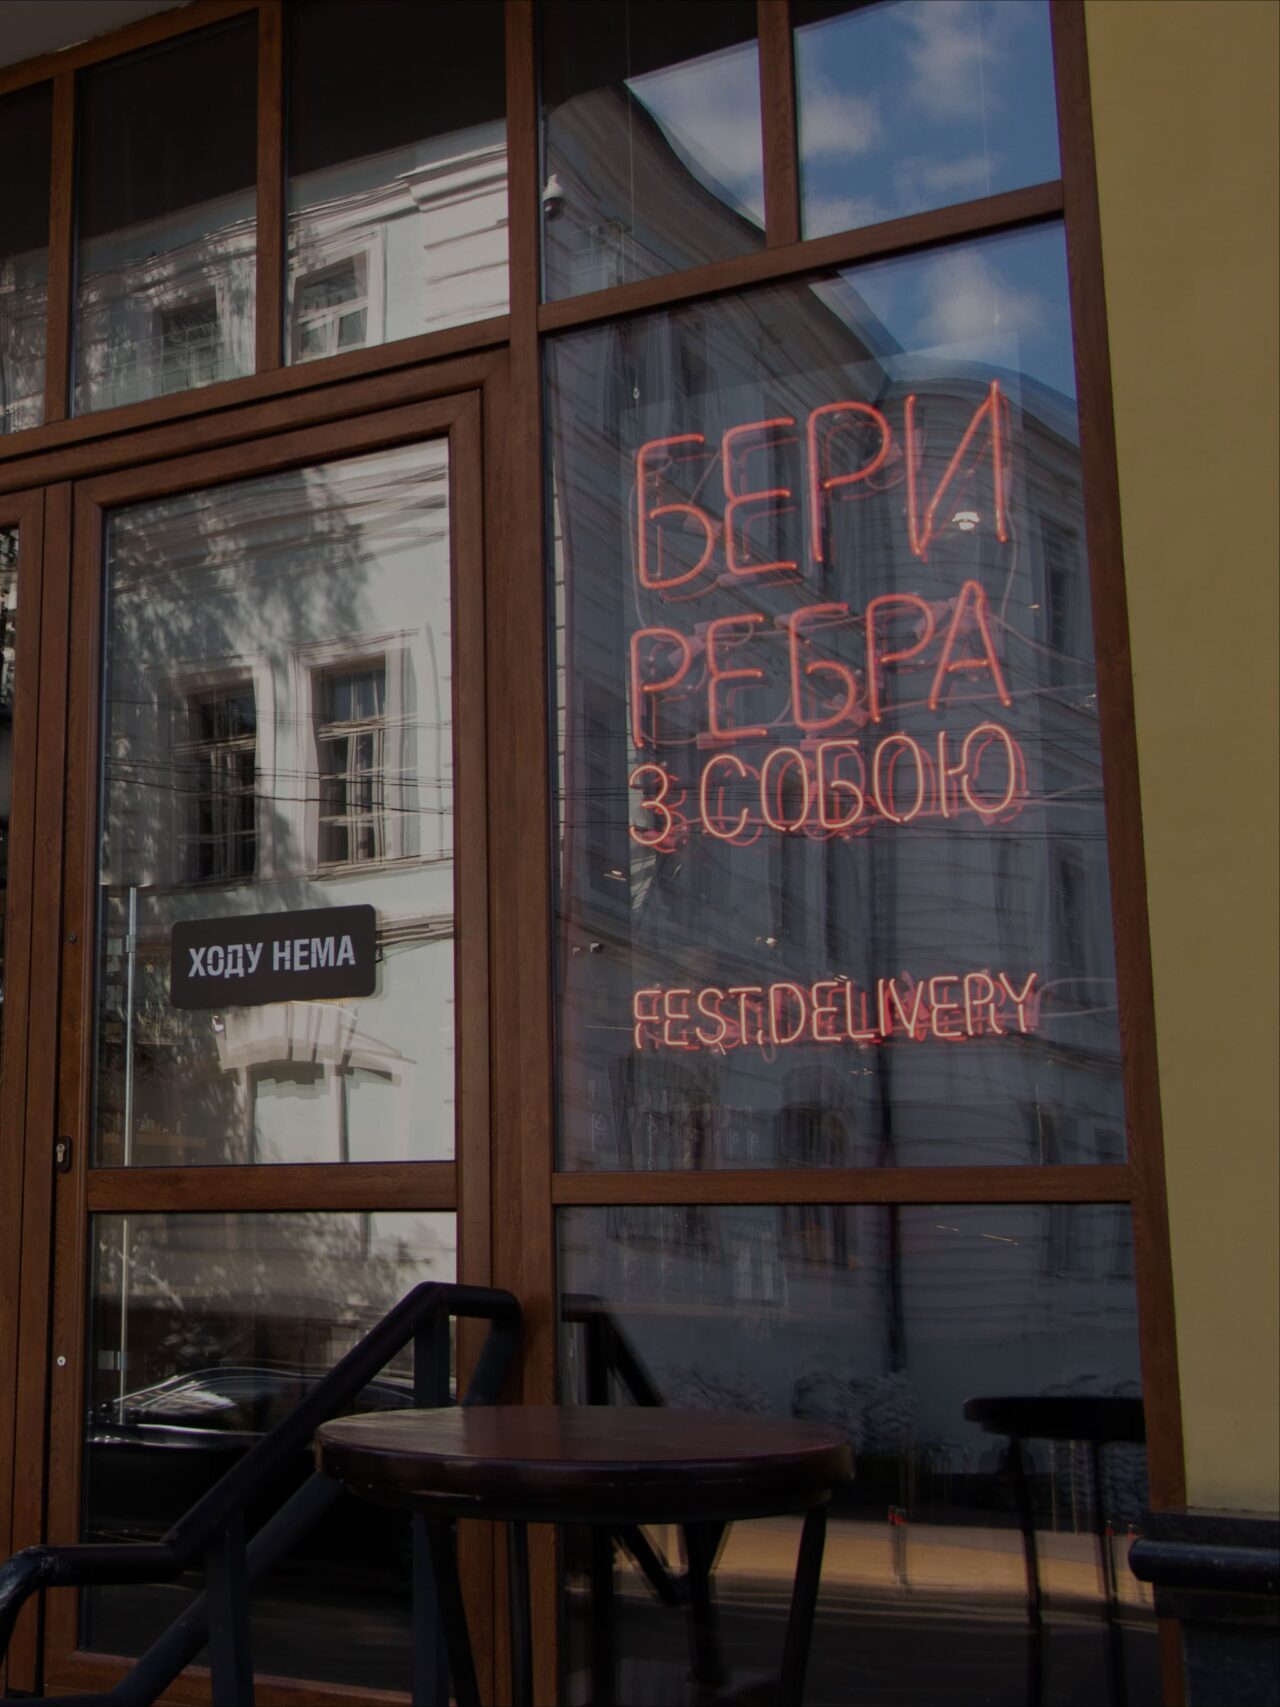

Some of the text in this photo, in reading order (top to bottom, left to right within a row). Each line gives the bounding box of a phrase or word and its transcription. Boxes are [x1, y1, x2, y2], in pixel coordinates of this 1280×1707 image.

[634, 379, 1011, 590] БЕРИ
[629, 578, 1013, 749] РЕБРА
[699, 722, 1017, 839] СОБОЮ
[187, 935, 357, 979] ХОДУ НЕМА
